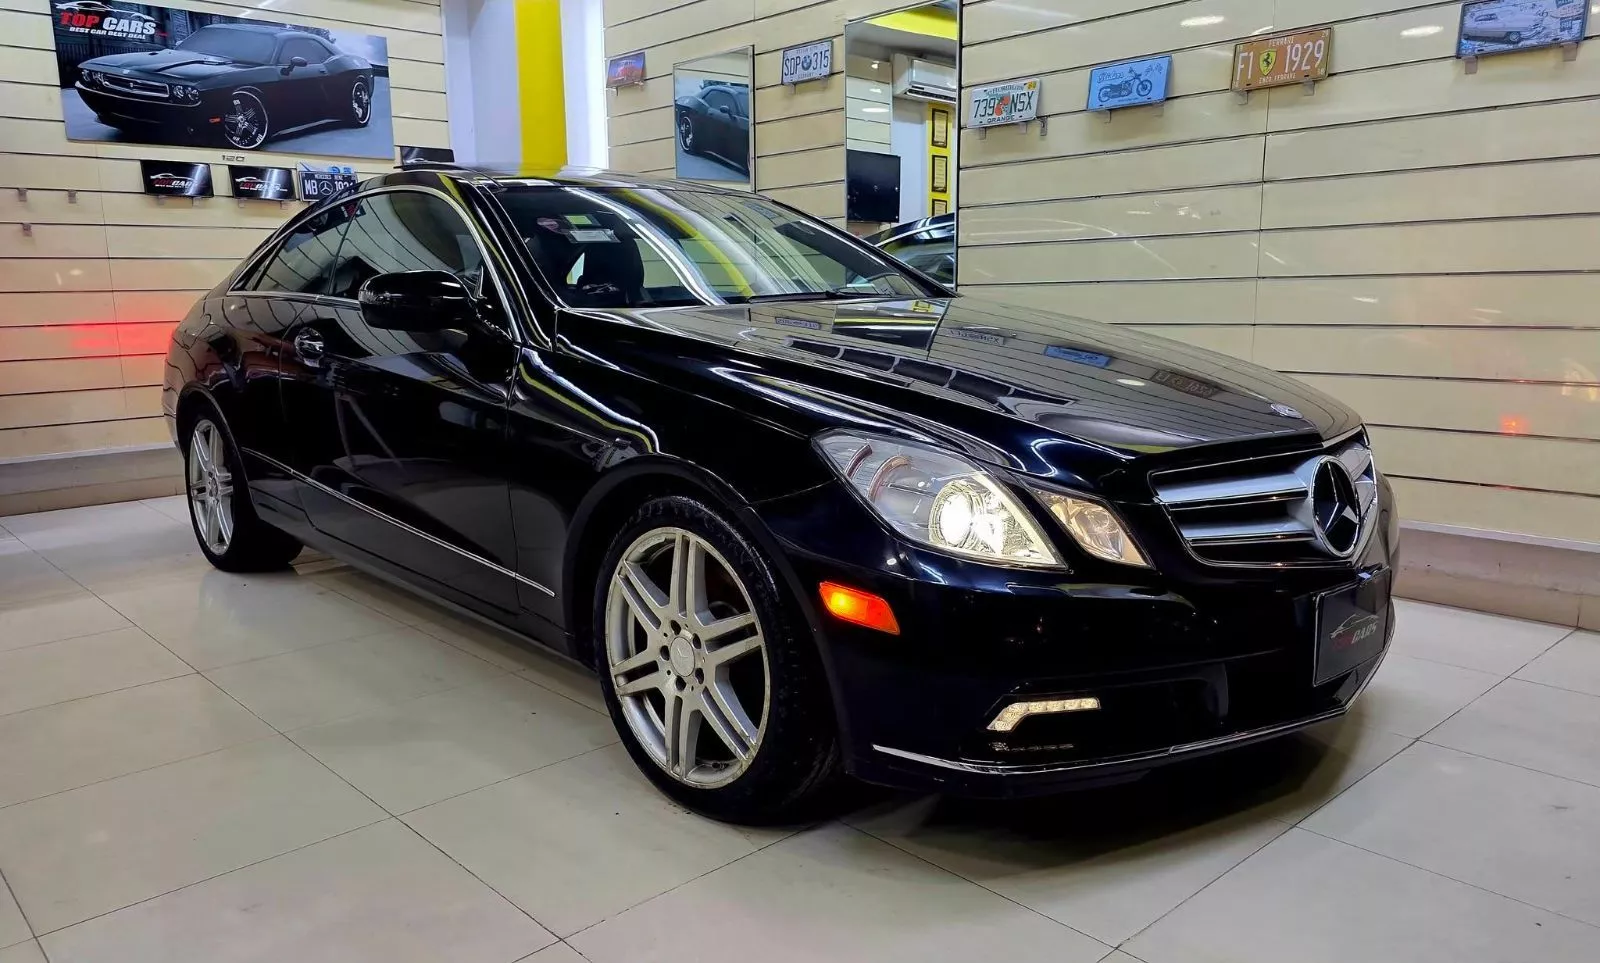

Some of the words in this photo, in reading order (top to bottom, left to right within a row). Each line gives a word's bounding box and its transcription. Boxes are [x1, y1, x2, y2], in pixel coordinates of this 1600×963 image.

[61, 12, 99, 27] TOP
[103, 17, 156, 35] CARS
[69, 26, 90, 34] BEST
[90, 28, 107, 36] CAR
[107, 30, 127, 38] BEST
[127, 32, 146, 40] DEAL
[812, 49, 830, 71] 315
[1285, 40, 1324, 73] 1929
[973, 97, 996, 119] 739
[1009, 91, 1034, 114] NSX
[304, 180, 318, 195] MB
